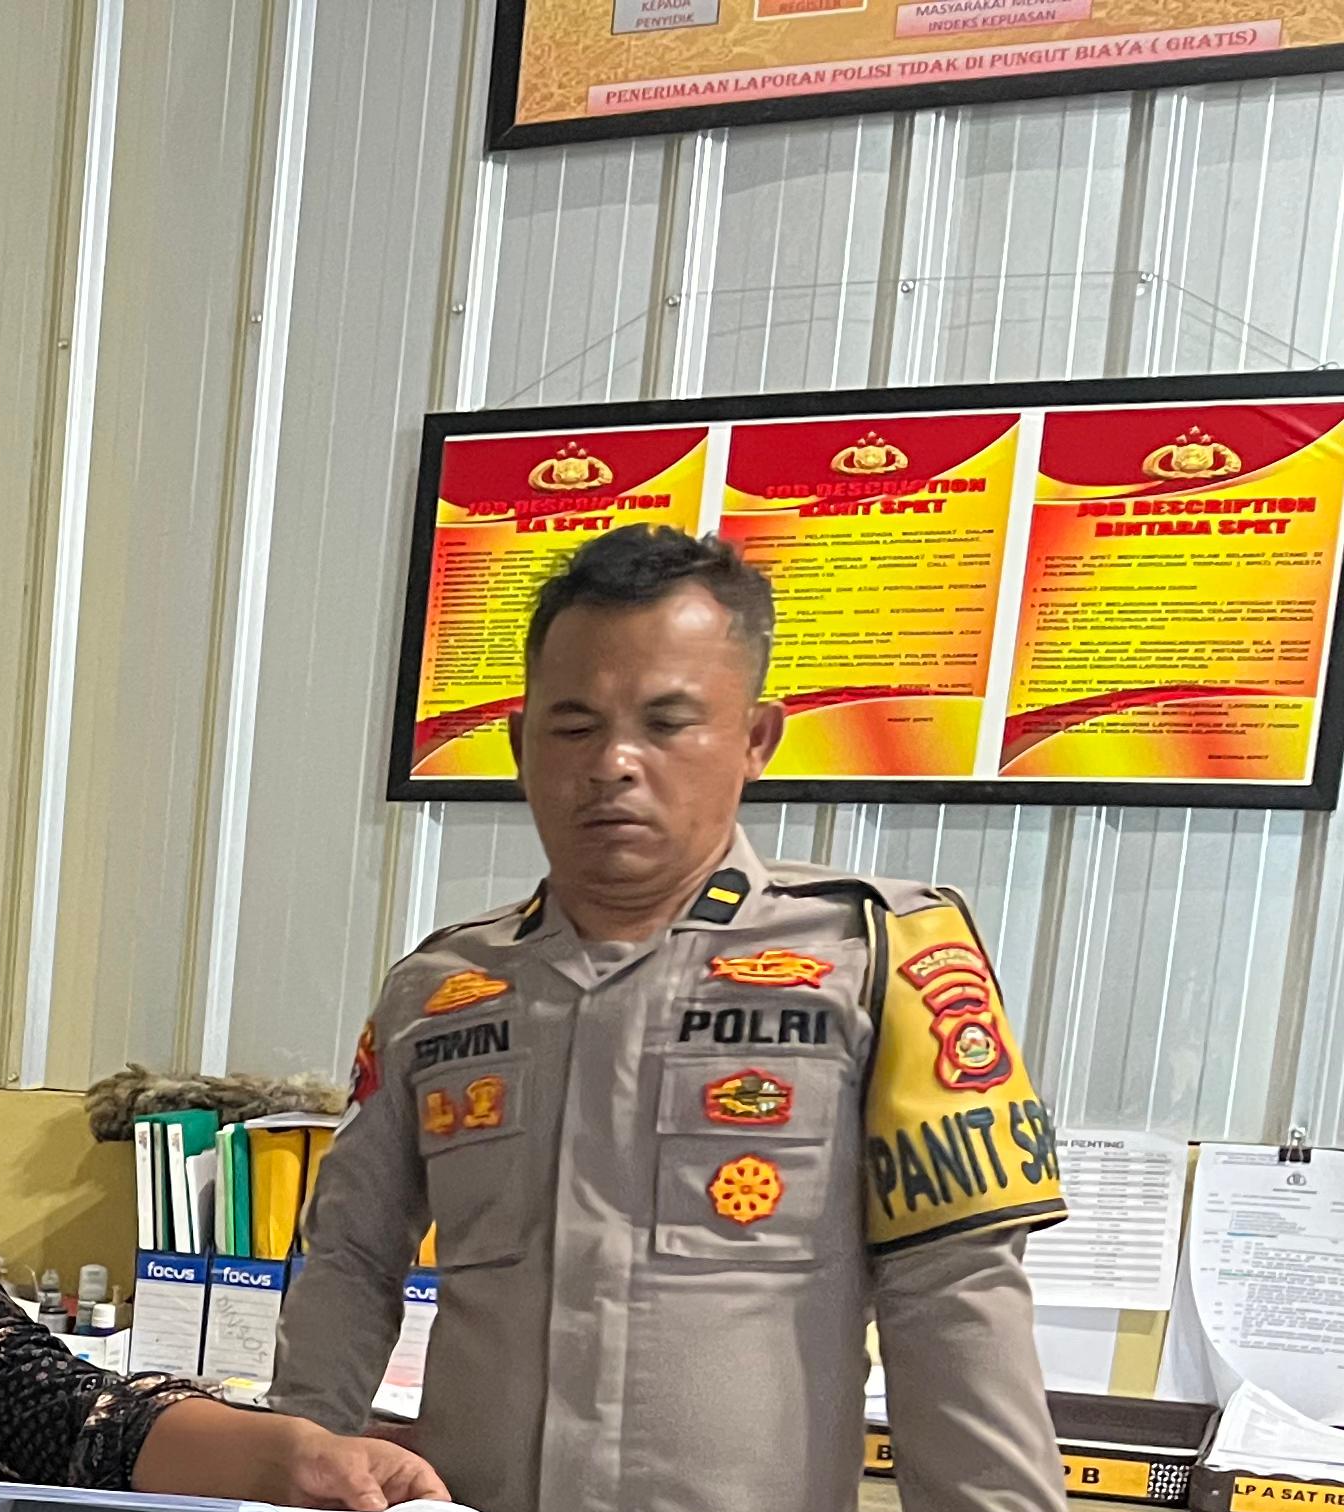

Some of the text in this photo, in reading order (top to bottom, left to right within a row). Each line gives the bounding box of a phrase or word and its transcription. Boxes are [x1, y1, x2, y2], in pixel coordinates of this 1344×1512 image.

[928, 10, 1056, 32] INDEKS KEPUASAN
[605, 79, 730, 105] PENERIMAAN
[733, 70, 827, 92] LAPORAN
[831, 63, 892, 82] POLISI
[900, 58, 958, 77] TIDAK
[965, 54, 984, 70] DI
[989, 47, 1070, 68] PUNGUT
[1075, 39, 1143, 61] BIAYA
[1075, 497, 1317, 518] JOB DESCRIPTION
[1094, 518, 1292, 538] BINTARA SPKT
[678, 1008, 828, 1045] POLRI
[868, 1106, 1009, 1221] PANIT
[147, 1261, 195, 1281] focus
[223, 1266, 272, 1287] focus
[405, 1286, 438, 1301] cus
[1234, 1484, 1257, 1496] LP
[1261, 1487, 1275, 1499] A
[1281, 1488, 1318, 1503] SAT
